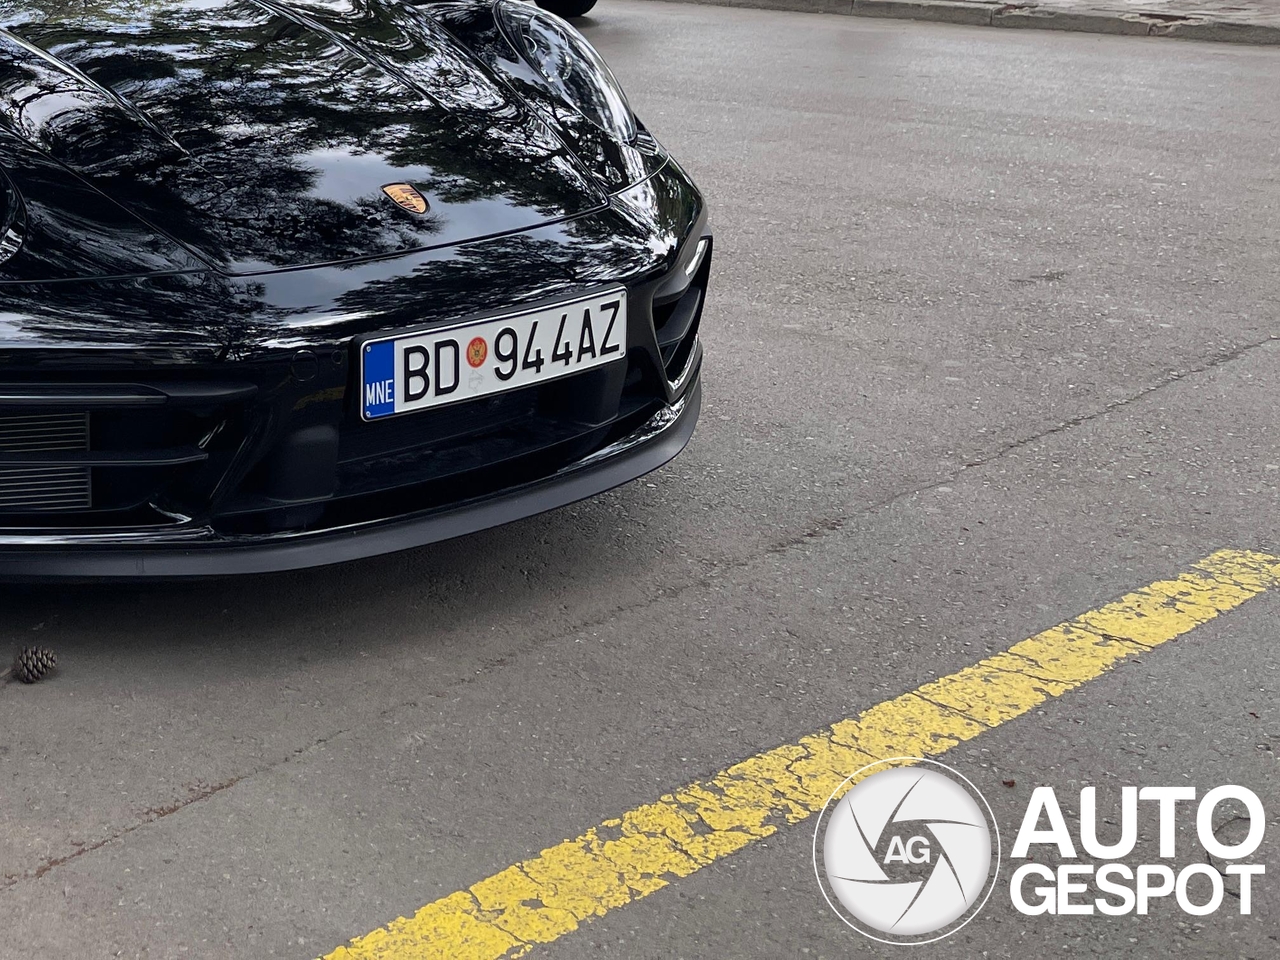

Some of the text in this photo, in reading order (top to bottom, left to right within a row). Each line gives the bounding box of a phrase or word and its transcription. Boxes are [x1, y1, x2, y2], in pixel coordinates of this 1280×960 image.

[366, 299, 621, 407] MNE BD 944AZ
